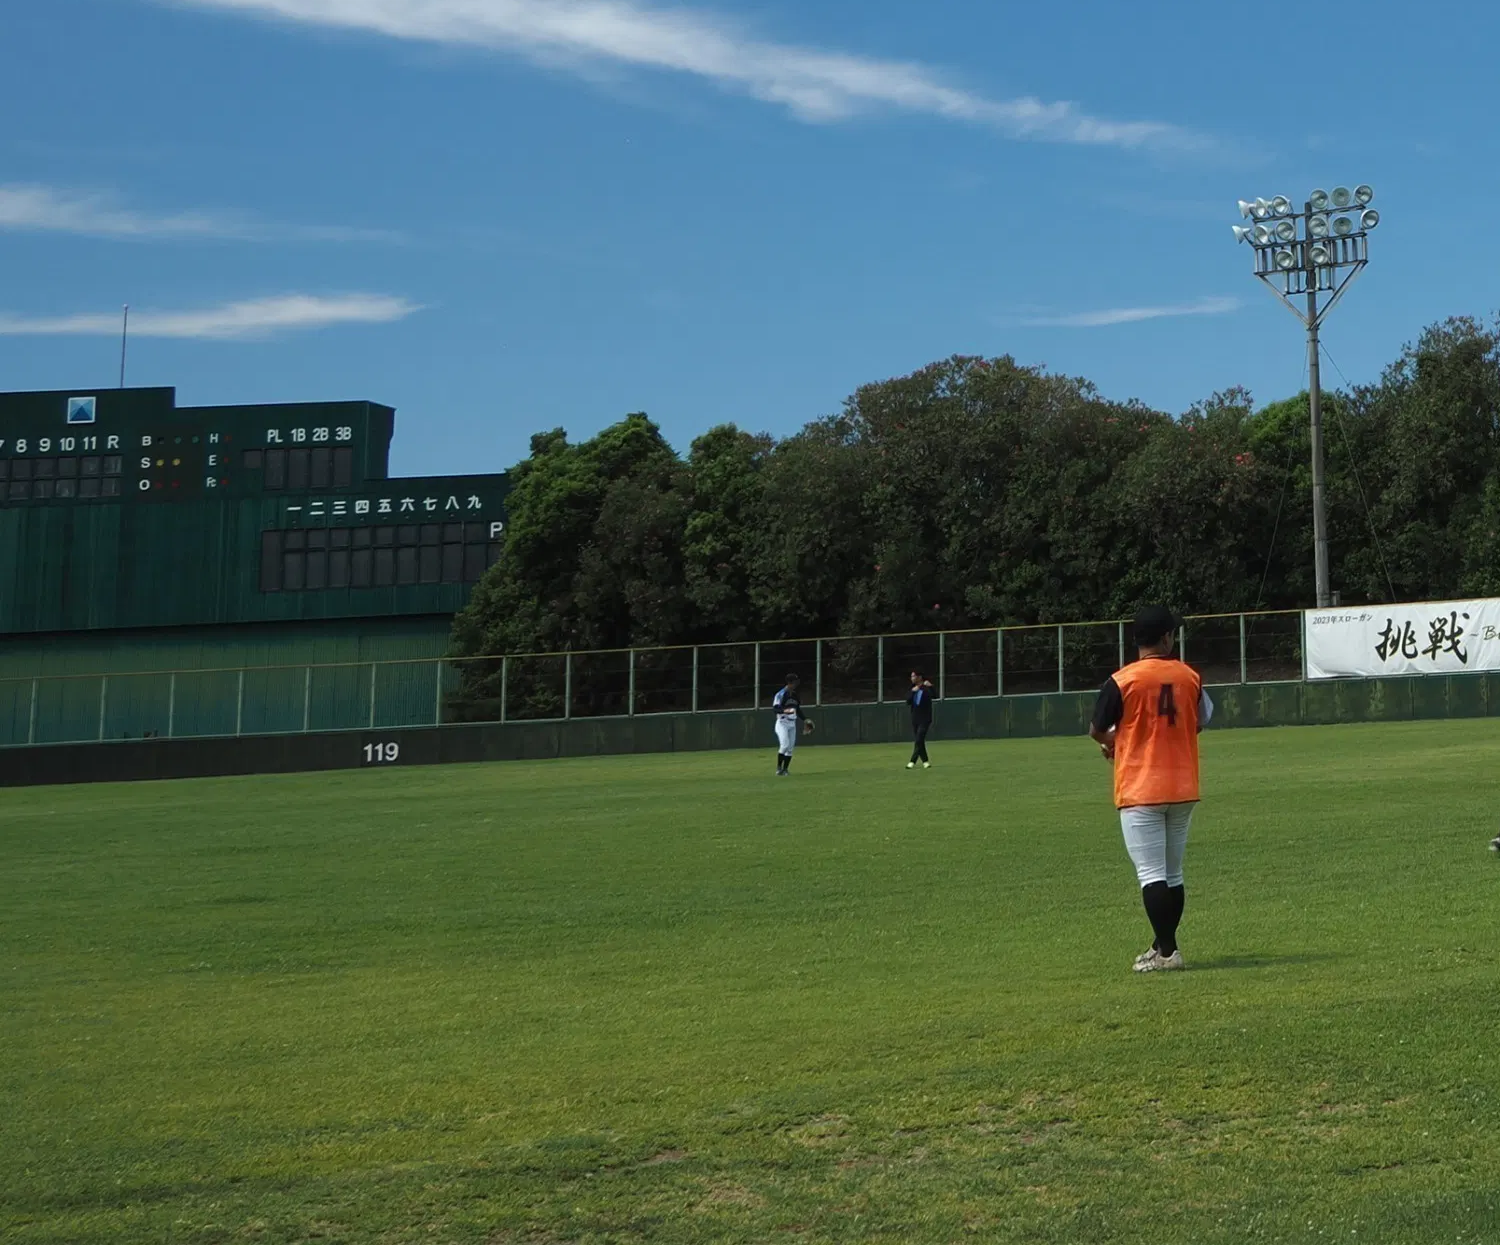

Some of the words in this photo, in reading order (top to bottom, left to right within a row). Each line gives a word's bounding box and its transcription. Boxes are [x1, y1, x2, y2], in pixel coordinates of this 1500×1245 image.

[141, 435, 152, 447] B
[209, 433, 219, 444] H
[267, 429, 283, 443] PL
[290, 428, 306, 442] 1B
[312, 427, 329, 442] 2B
[335, 427, 352, 441] 3B
[15, 438, 27, 453] 8
[38, 437, 51, 452] 9
[59, 437, 75, 451] 10
[83, 436, 97, 450] 11
[107, 435, 119, 449] R
[141, 457, 150, 469] S
[208, 454, 217, 466] E
[1312, 613, 1373, 625] 2023年スローガン
[1374, 610, 1470, 665] 挑戦
[1157, 683, 1178, 727] 4
[363, 742, 399, 762] 119
